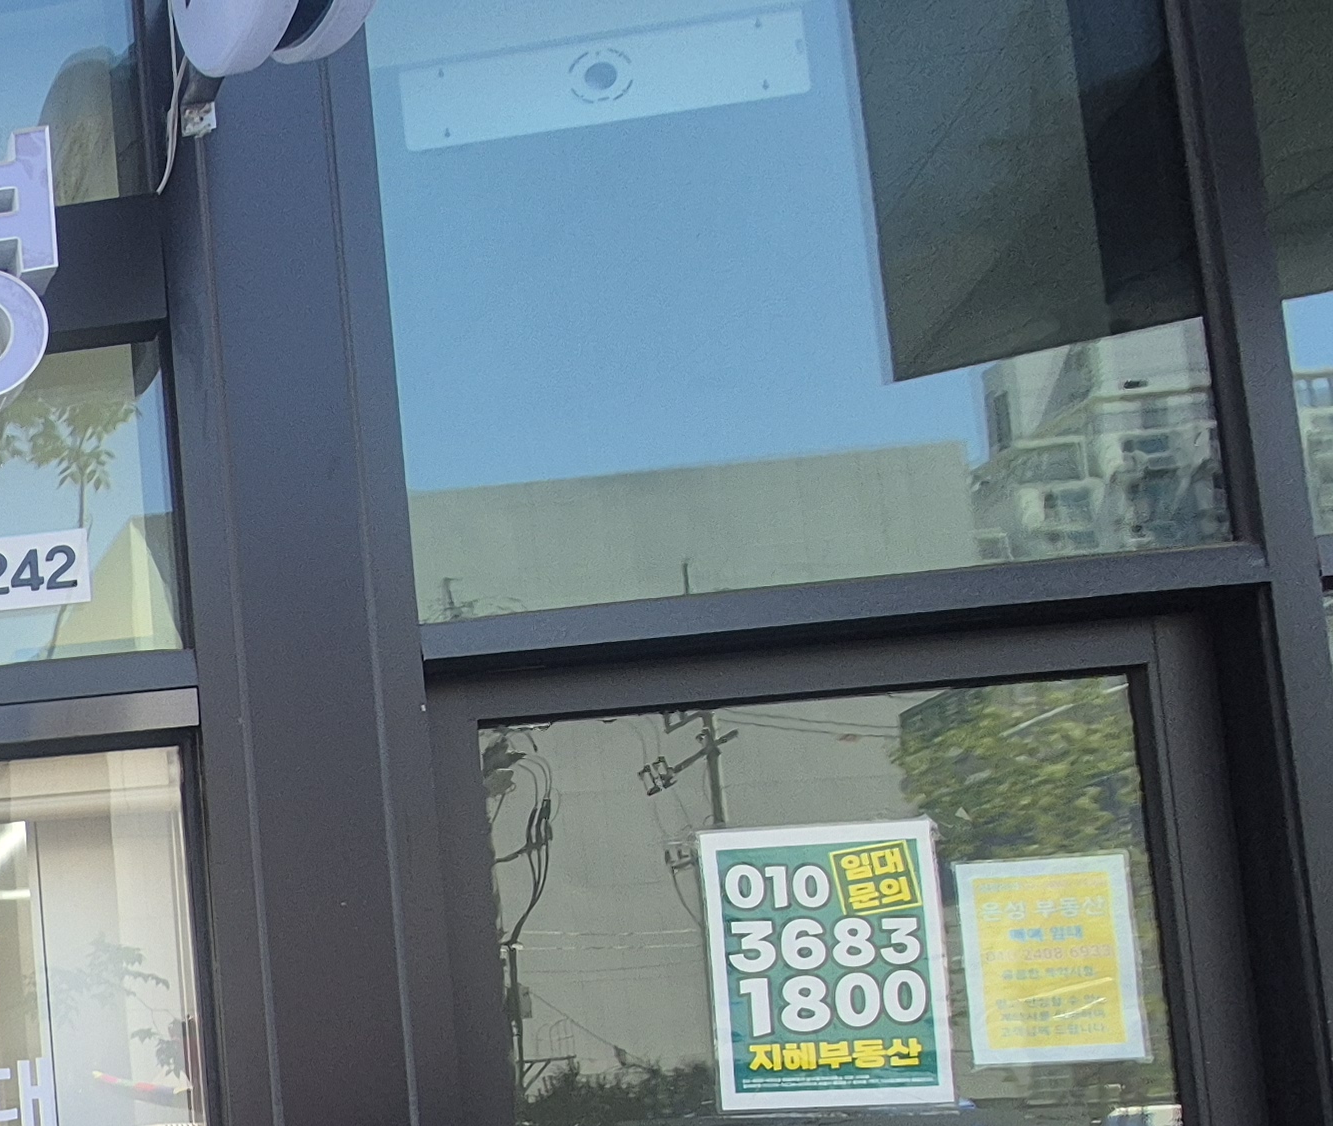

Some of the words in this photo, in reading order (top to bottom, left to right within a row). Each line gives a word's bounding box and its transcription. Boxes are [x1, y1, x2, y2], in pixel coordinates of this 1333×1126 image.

[841, 847, 904, 877] 임대
[725, 865, 830, 909] 010
[847, 877, 912, 910] 문의
[1035, 896, 1107, 918] 부동산
[729, 917, 922, 972] 3683
[739, 969, 927, 1037] 1800
[749, 1037, 923, 1071] 지혜부동산
